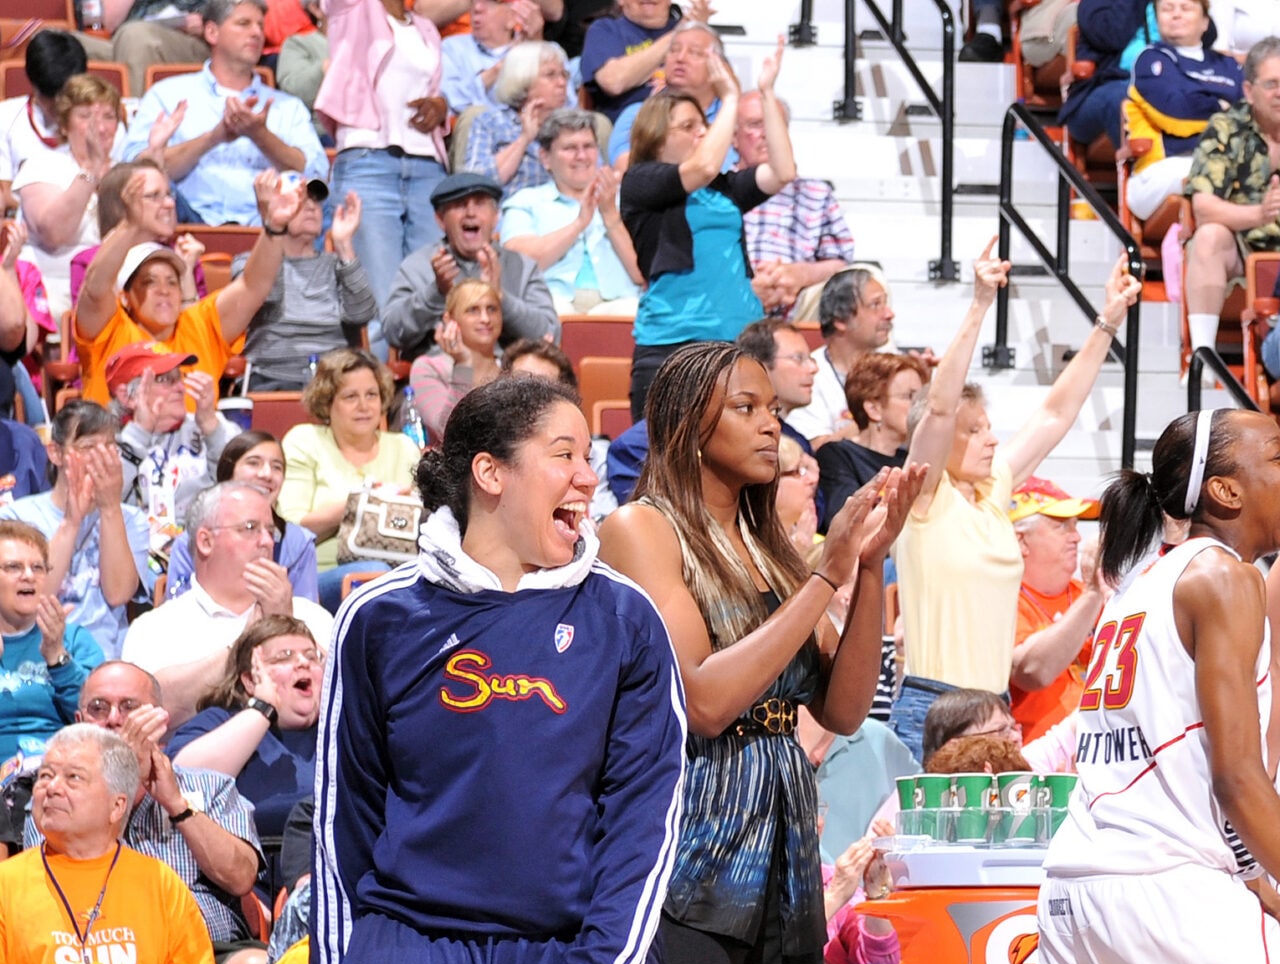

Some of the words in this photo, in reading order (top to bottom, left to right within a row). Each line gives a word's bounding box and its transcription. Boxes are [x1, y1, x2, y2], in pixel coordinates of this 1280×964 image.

[440, 648, 567, 715] Sun
[1079, 611, 1147, 712] 23
[86, 926, 136, 946] MUCH
